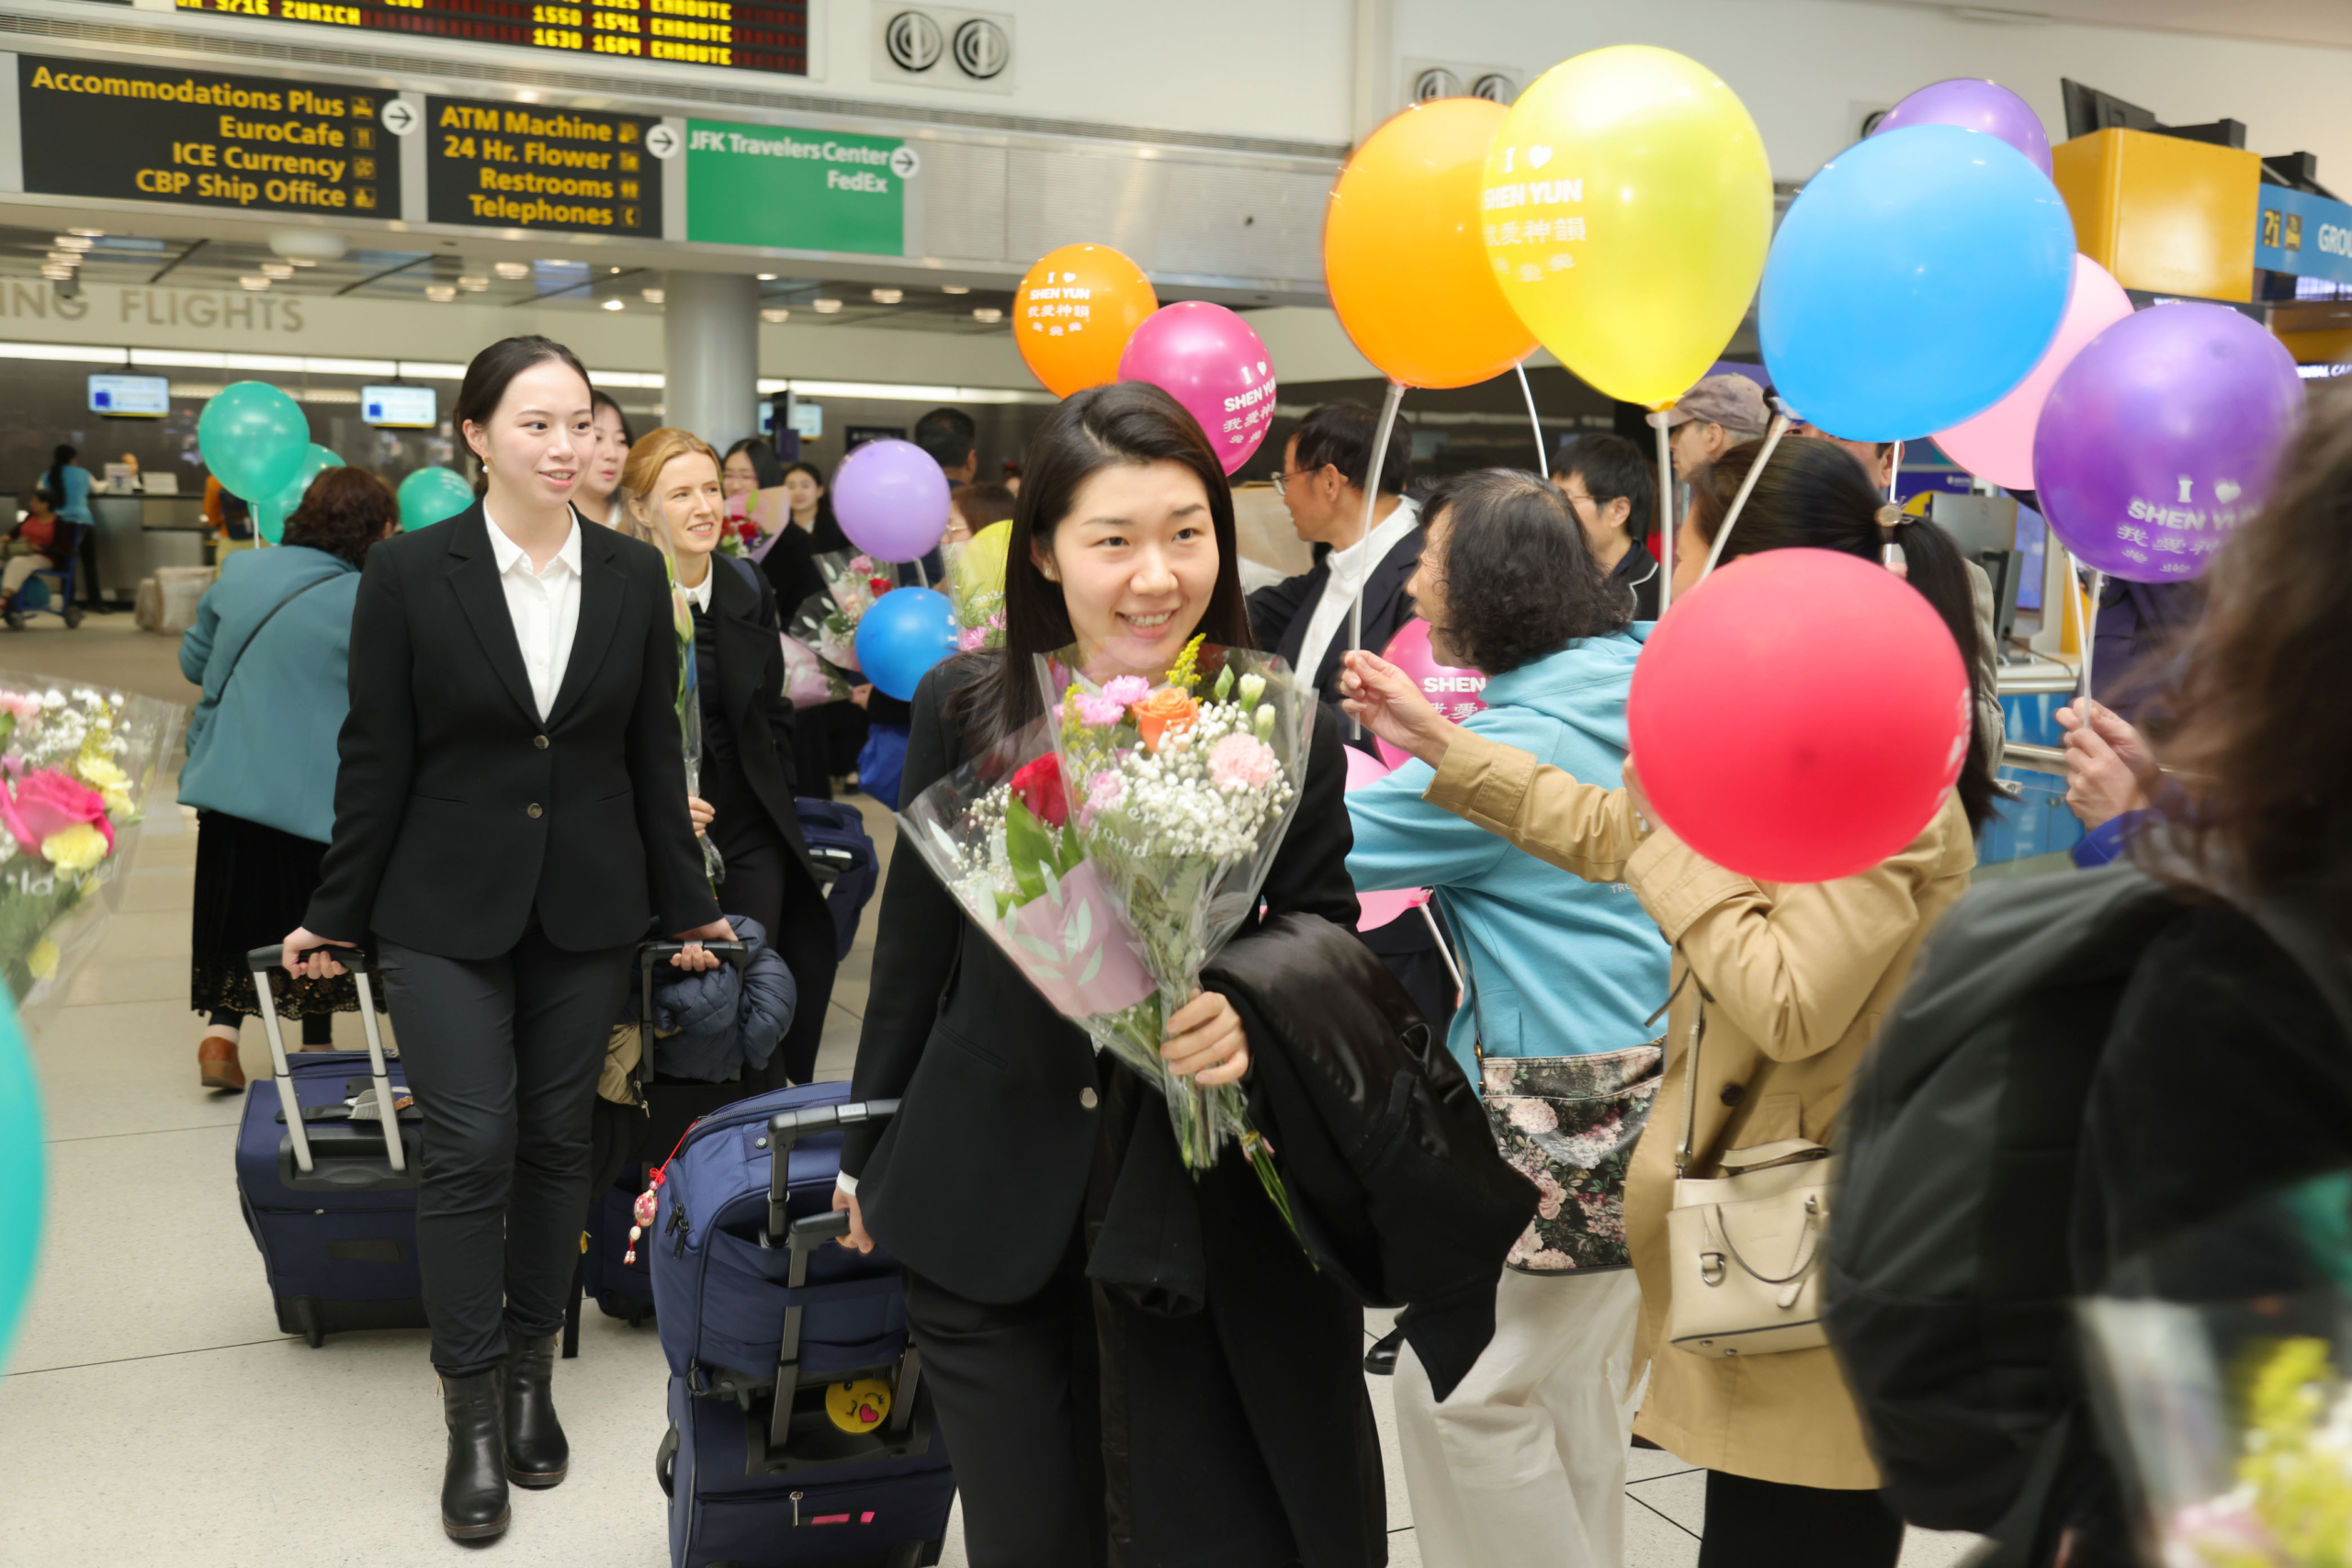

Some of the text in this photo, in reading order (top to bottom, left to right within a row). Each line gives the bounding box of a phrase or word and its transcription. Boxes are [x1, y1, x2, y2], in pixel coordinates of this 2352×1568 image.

[281, 1, 361, 26] ZURICH
[533, 28, 582, 50] 1630
[533, 5, 582, 26] 1550
[31, 66, 345, 117] Accommodations Plus
[219, 115, 345, 147] EuroCafe
[440, 106, 613, 142] ATM Machine
[173, 142, 345, 182] ICE Currency
[444, 135, 612, 171] 24 Hr. Flower
[689, 130, 889, 166] JFK Travelers Center
[1504, 146, 1516, 174] I
[136, 169, 346, 207] CBP Ship Office
[480, 167, 614, 199] Restrooms
[827, 169, 888, 194] FedEx
[1484, 177, 1584, 211] SHEN YUN
[469, 194, 614, 226] Telephones
[1030, 288, 1091, 300] SHEN YUN
[1047, 272, 1056, 284] I
[120, 288, 305, 333] FLIGHTS
[1241, 367, 1252, 385] I
[1224, 387, 1263, 412] SHEN
[2177, 479, 2193, 502] I
[2128, 499, 2206, 532] SHEN
[1424, 677, 1487, 694] SHEN
